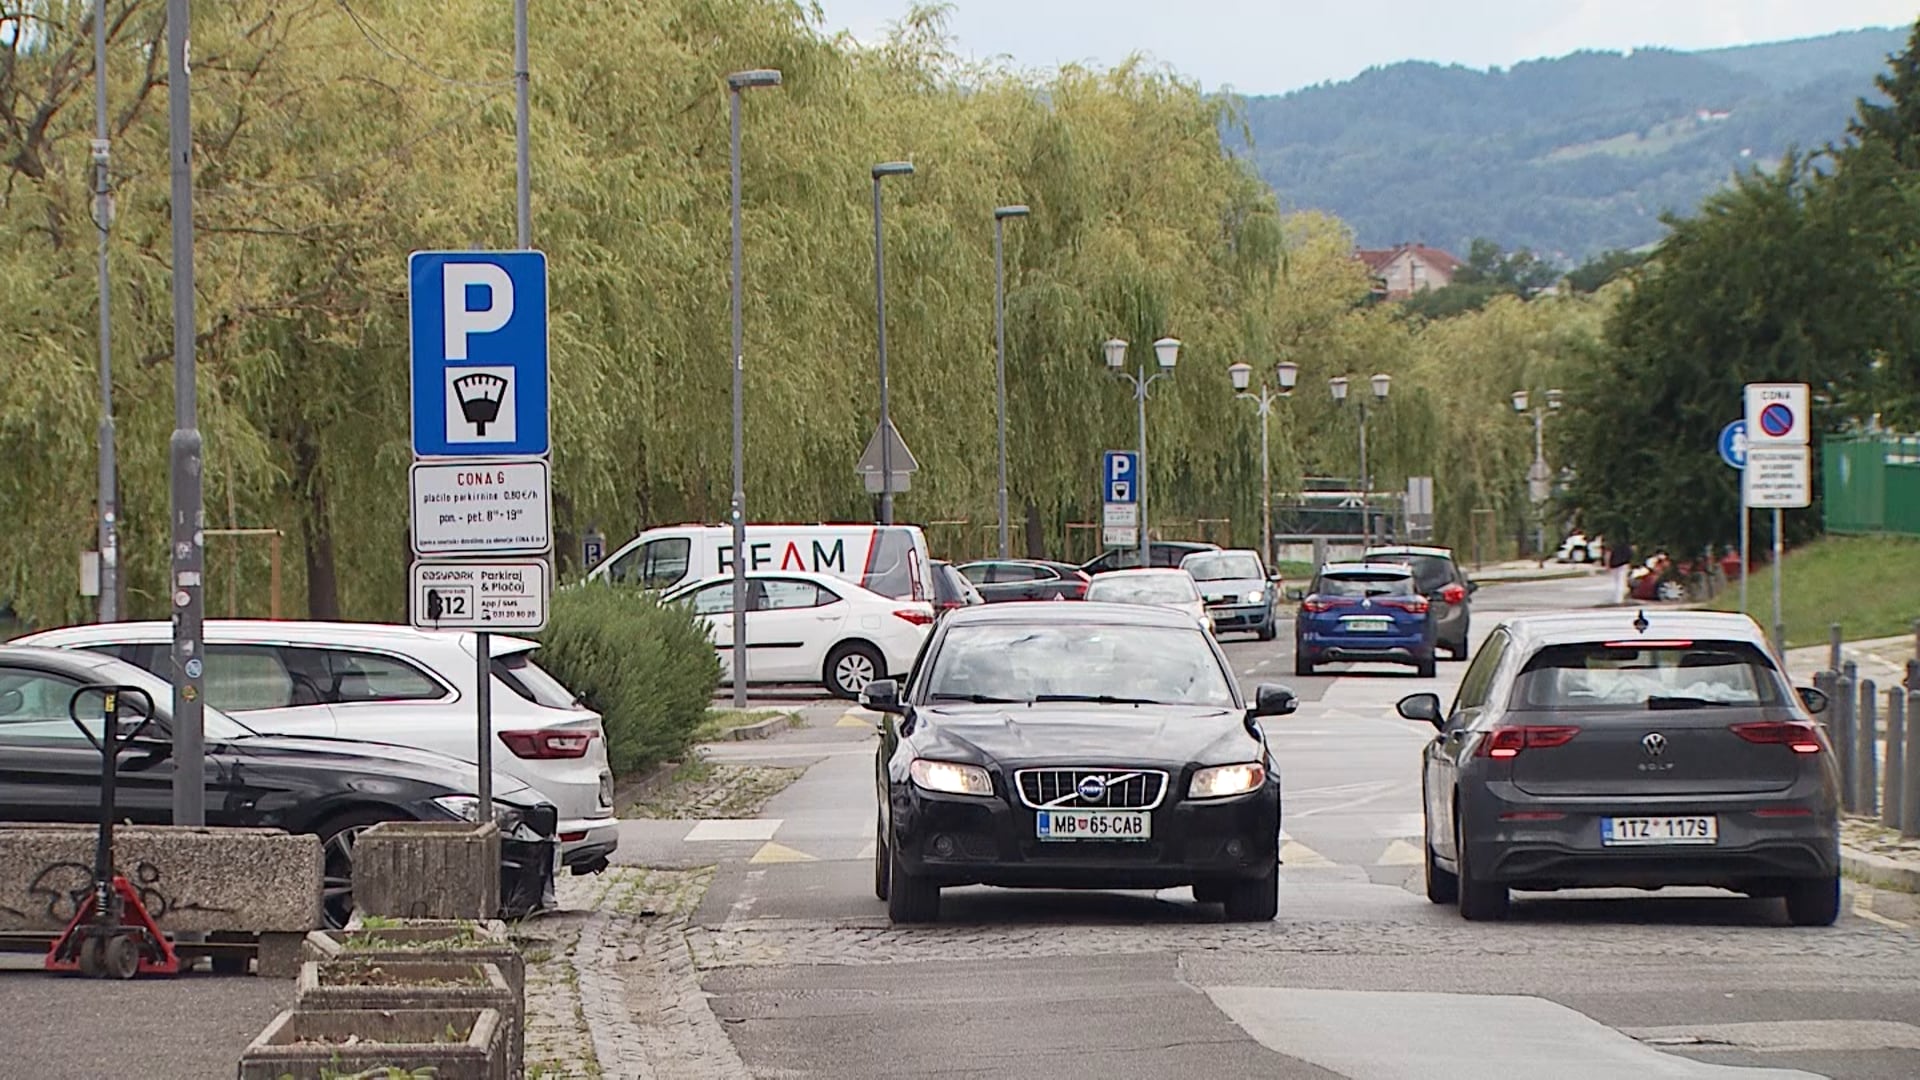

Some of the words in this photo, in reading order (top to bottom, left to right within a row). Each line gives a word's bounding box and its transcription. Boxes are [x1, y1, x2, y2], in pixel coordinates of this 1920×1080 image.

[443, 262, 514, 361] P
[1111, 455, 1130, 480] P
[457, 472, 493, 486] CONA
[481, 570, 522, 582] Parkiraj
[481, 582, 489, 591] &
[481, 600, 496, 608] App
[1054, 815, 1077, 834] MB
[1089, 815, 1143, 834] 65-CAB
[1618, 818, 1650, 838] 1TZ
[1665, 818, 1709, 837] 1179
